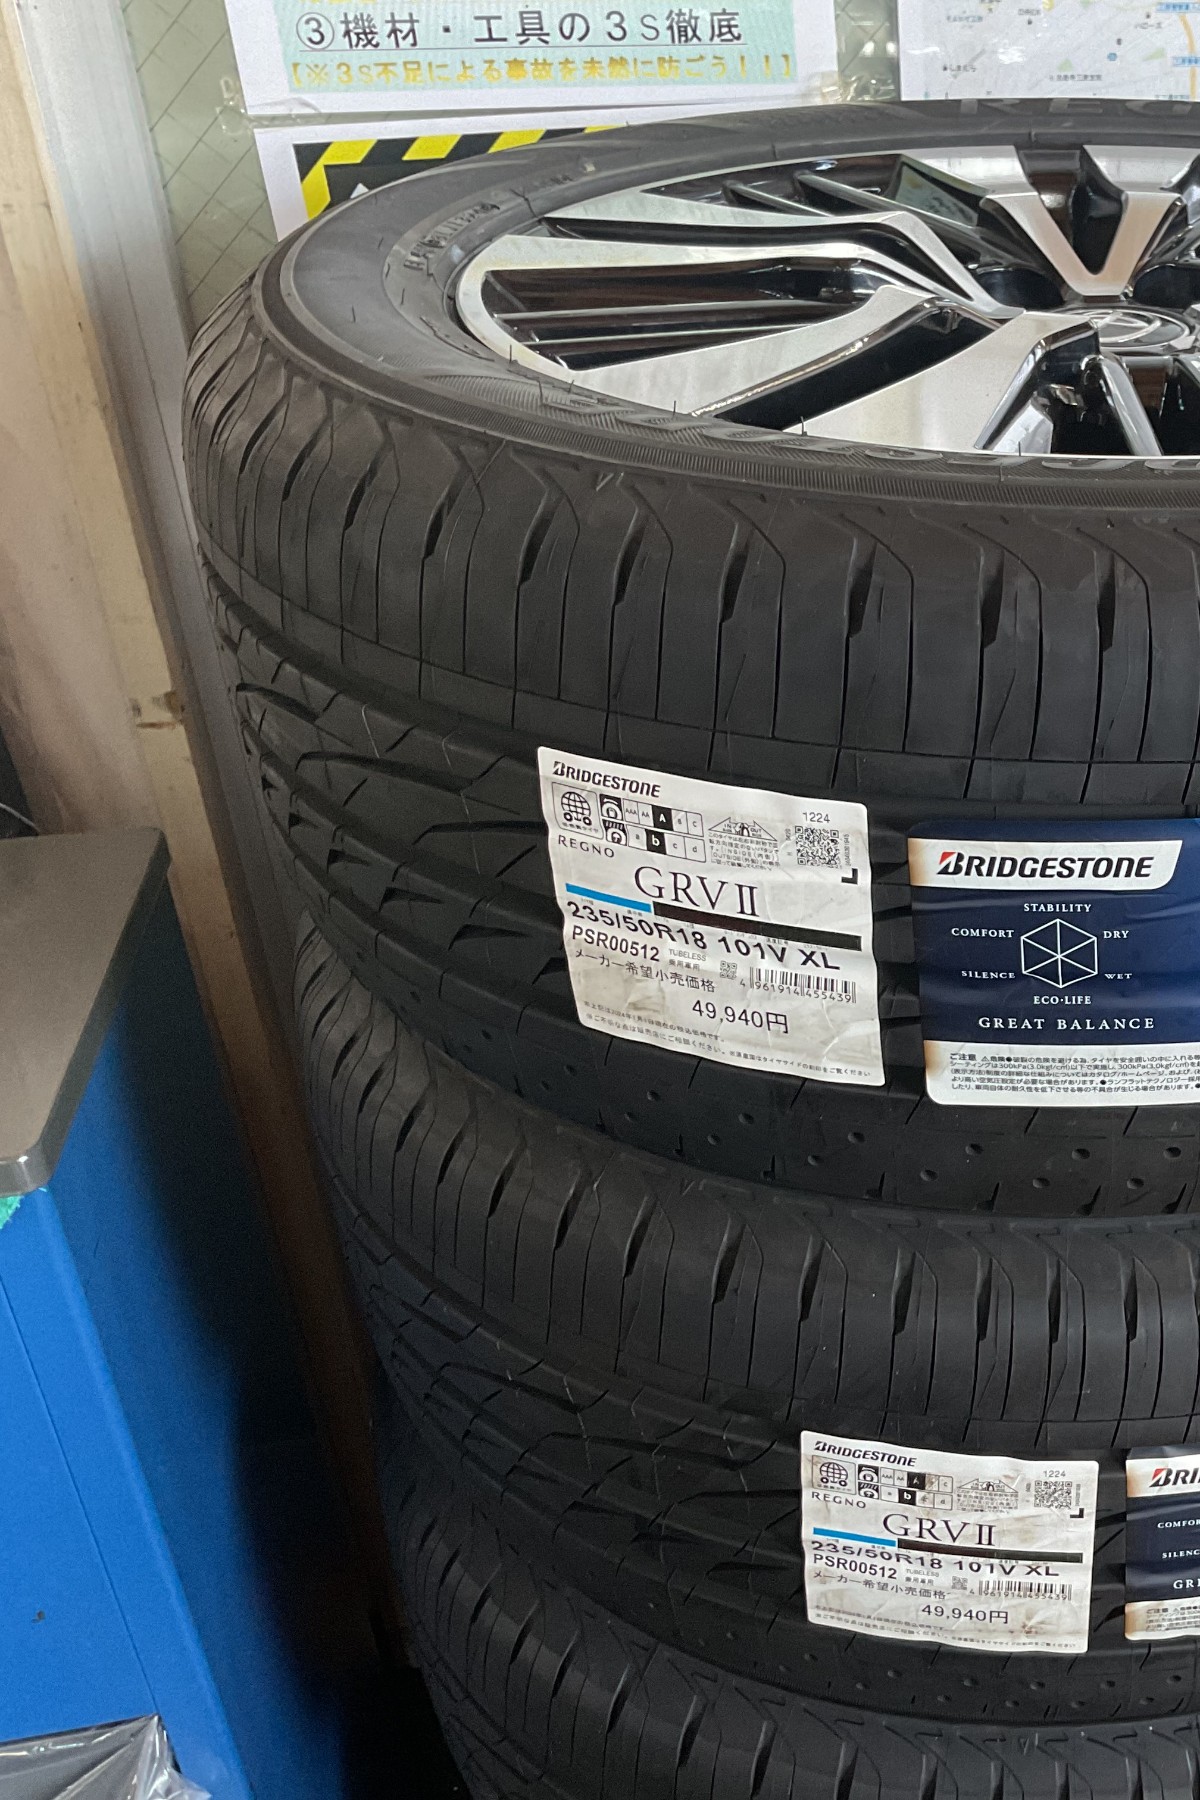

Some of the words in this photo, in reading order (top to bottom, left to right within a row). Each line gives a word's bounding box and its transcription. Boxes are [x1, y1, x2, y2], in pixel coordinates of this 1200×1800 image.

[553, 761, 661, 798] BRIDGESTONE
[802, 811, 831, 824] 1224
[558, 834, 615, 858] REGNO
[936, 851, 1154, 879] BRIDGESTONE
[1023, 903, 1092, 913] STABILITY
[567, 901, 708, 950] 235/50R18
[718, 936, 787, 963] 101V
[798, 948, 841, 971] XL
[572, 925, 660, 962] PSR00512
[951, 927, 1015, 938] COMFORT
[1103, 930, 1129, 940] DRY
[668, 948, 707, 962] TUBELESS
[575, 948, 716, 993] メーカー希望小売価格
[961, 970, 1016, 979] SILENCE
[739, 979, 746, 988] 4
[692, 1000, 789, 1034] 49,940円
[978, 1016, 1045, 1030] GREAT
[1057, 1017, 1155, 1030] BALANCE
[950, 1052, 977, 1062] ご注意
[814, 1440, 918, 1467] BRIDGESTONE
[1043, 1470, 1066, 1478] 1224
[811, 1491, 867, 1509] REGNO
[811, 1540, 943, 1570] 235/50R18
[953, 1560, 1017, 1576] 101V
[1025, 1565, 1060, 1577] XL
[813, 1553, 897, 1580] PSR00512
[813, 1570, 946, 1600] メーカー希望小売価格
[921, 1604, 1009, 1624] 49,940円
